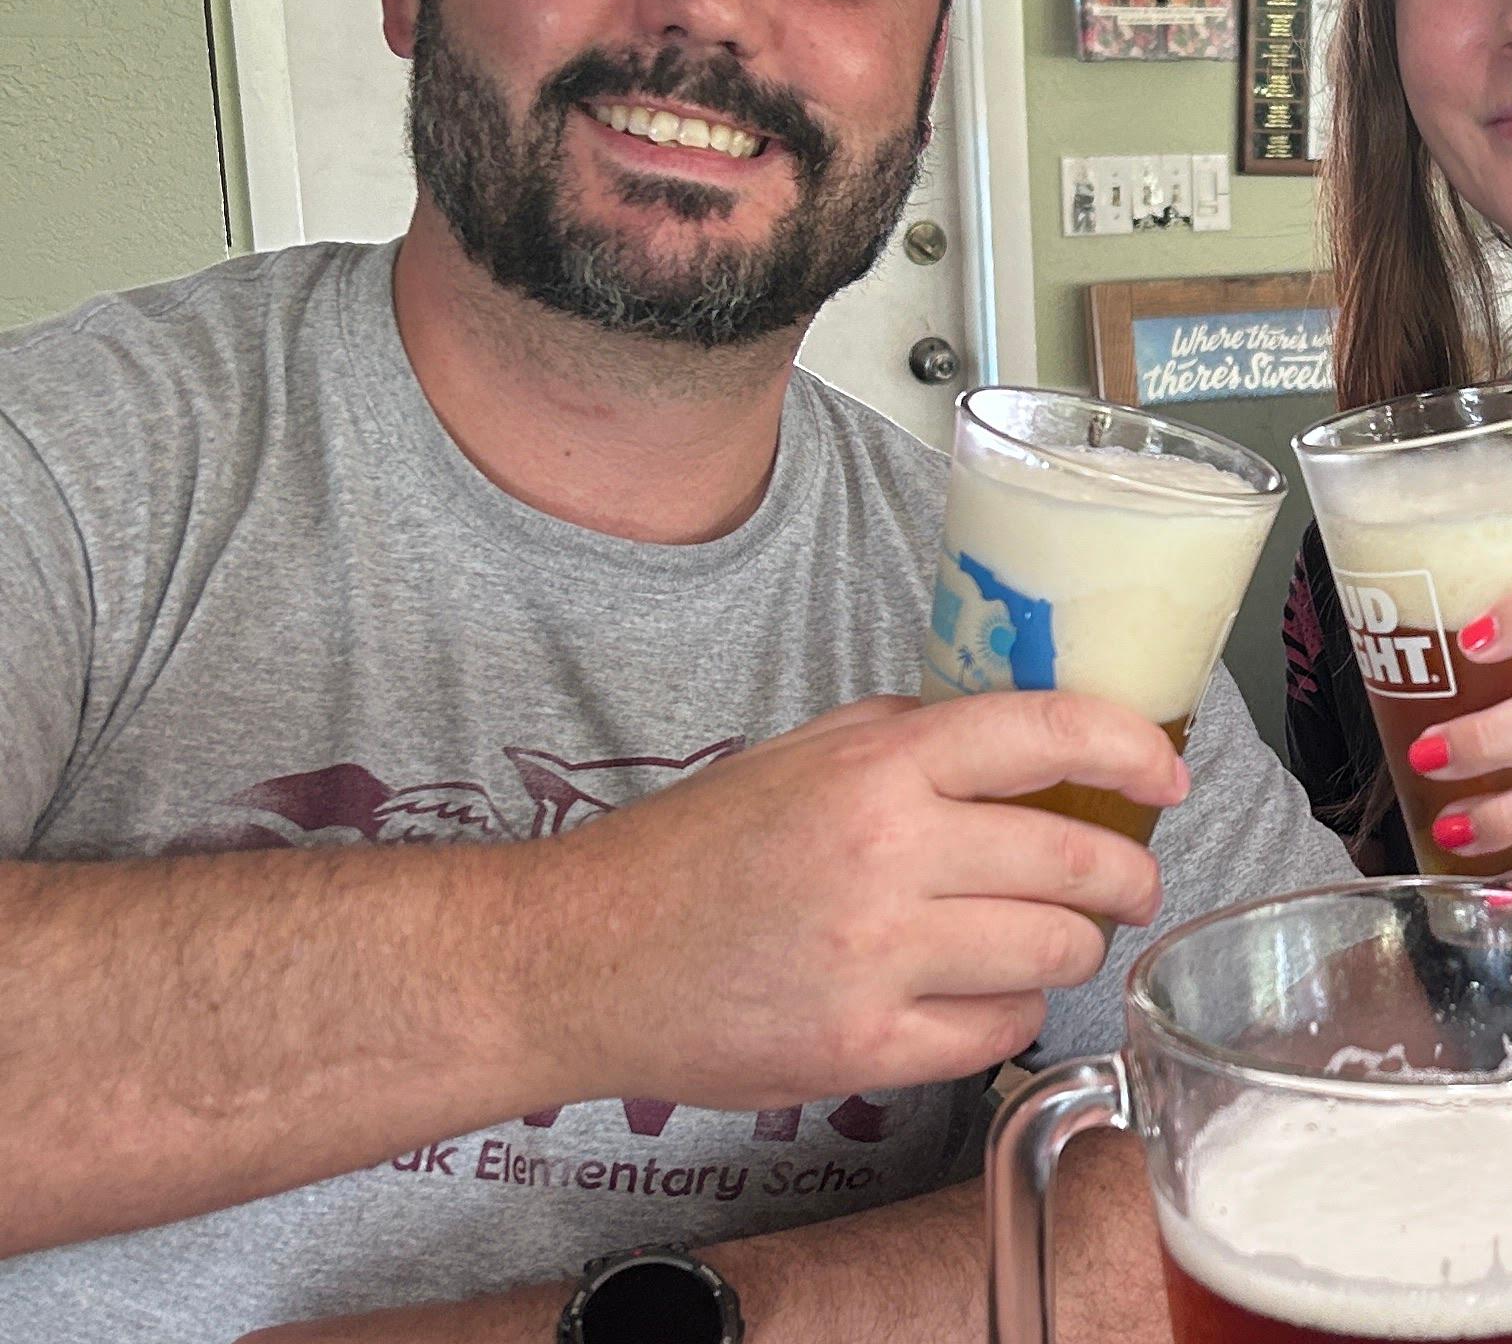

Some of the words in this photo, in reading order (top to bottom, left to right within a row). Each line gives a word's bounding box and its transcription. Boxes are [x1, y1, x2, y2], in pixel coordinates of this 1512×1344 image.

[1171, 321, 1245, 359] Where
[1246, 323, 1309, 352] there's
[1142, 356, 1242, 401] there's
[474, 1138, 748, 1201] Elementary
